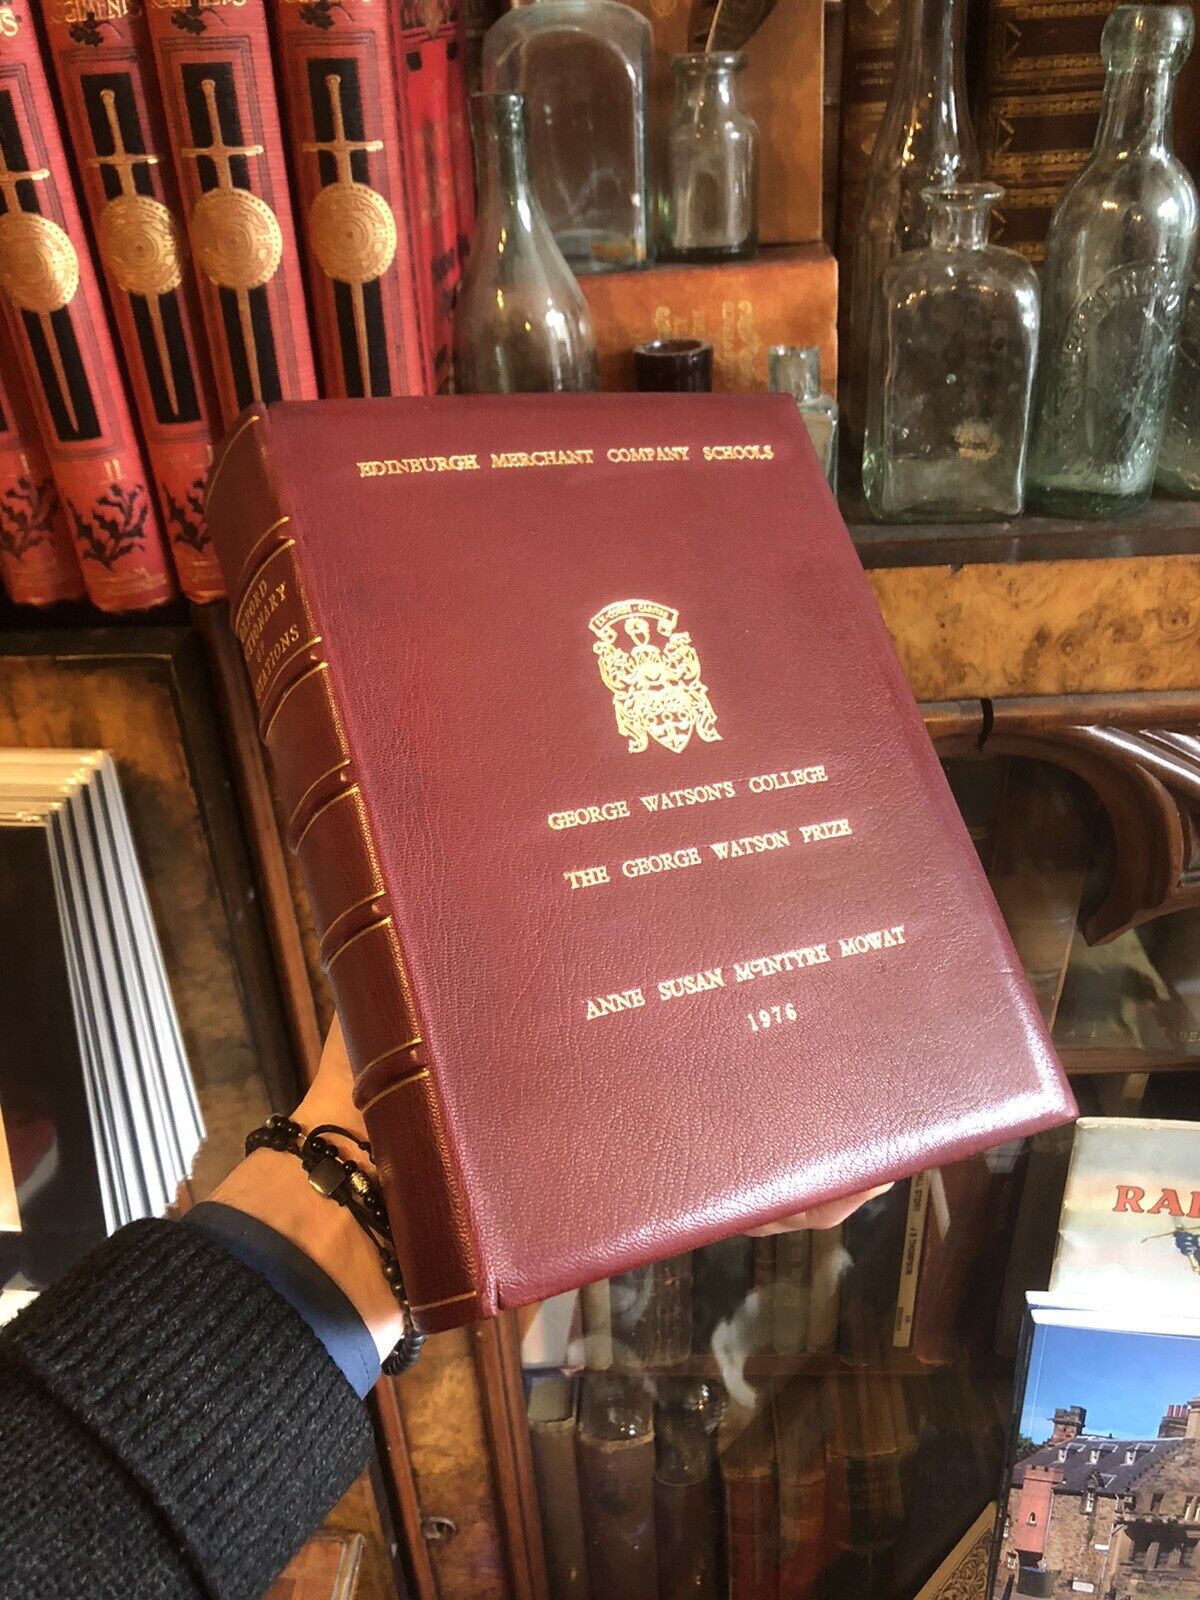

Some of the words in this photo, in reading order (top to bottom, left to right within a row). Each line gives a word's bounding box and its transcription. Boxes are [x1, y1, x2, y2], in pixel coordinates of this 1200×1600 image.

[356, 453, 481, 478] EDINBURGH
[490, 449, 594, 469] MERCHANT
[606, 445, 690, 464] COMPANY
[702, 444, 775, 462] SCHOOLS
[547, 800, 631, 831] GEORGE
[640, 780, 736, 813] WATSON'S
[748, 764, 829, 794] COLLEGE
[563, 865, 611, 890] THE
[621, 847, 702, 879] GEORGE
[709, 830, 791, 860] WATSON
[798, 818, 853, 844] PRIZE
[585, 988, 646, 1021] ANNE
[657, 967, 727, 1001] SUSAN
[838, 924, 906, 958] MOWAT
[747, 1002, 798, 1032] 1976
